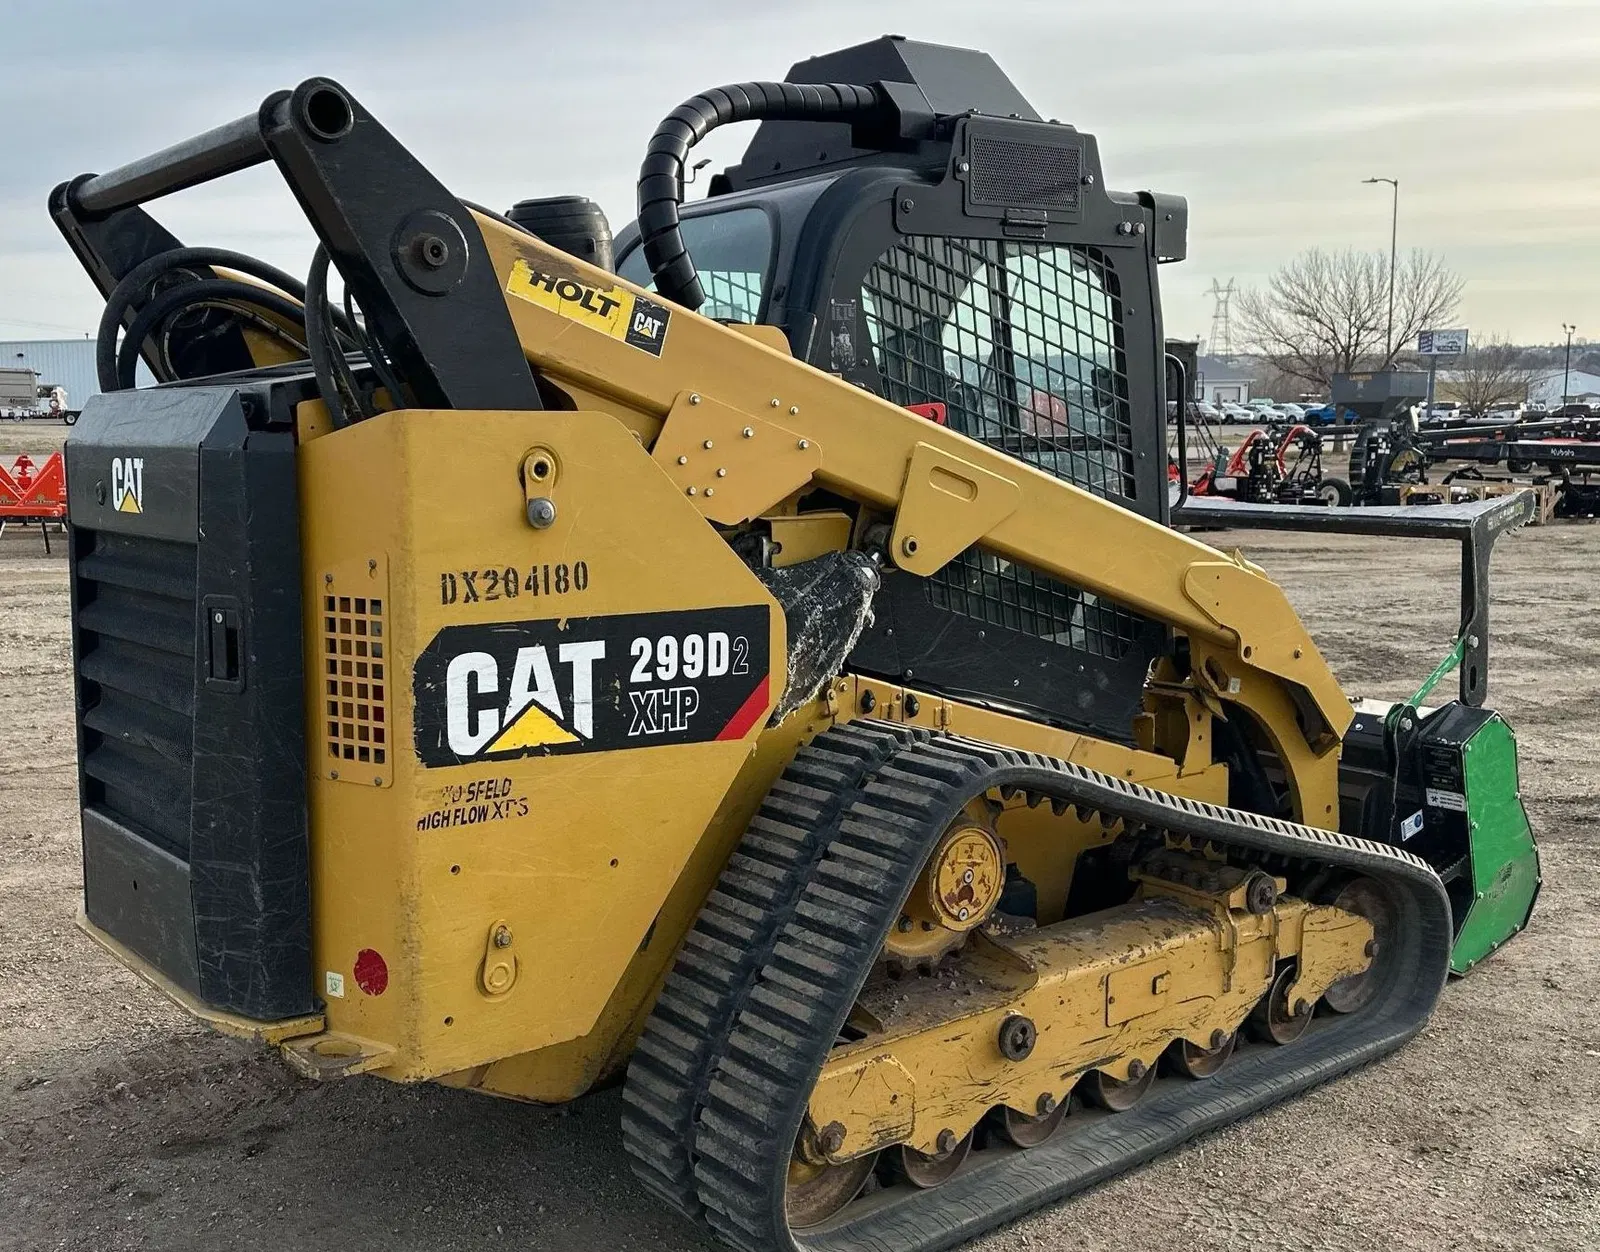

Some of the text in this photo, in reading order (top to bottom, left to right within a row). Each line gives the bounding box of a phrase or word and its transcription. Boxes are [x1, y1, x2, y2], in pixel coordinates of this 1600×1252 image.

[529, 270, 620, 318] HOLT
[633, 312, 662, 340] CAT
[112, 457, 144, 514] CAT
[441, 561, 589, 605] DX204180
[446, 640, 606, 756] CAT
[628, 686, 700, 737] XHP
[416, 809, 451, 831] HIGH
[453, 805, 489, 826] FLOW
